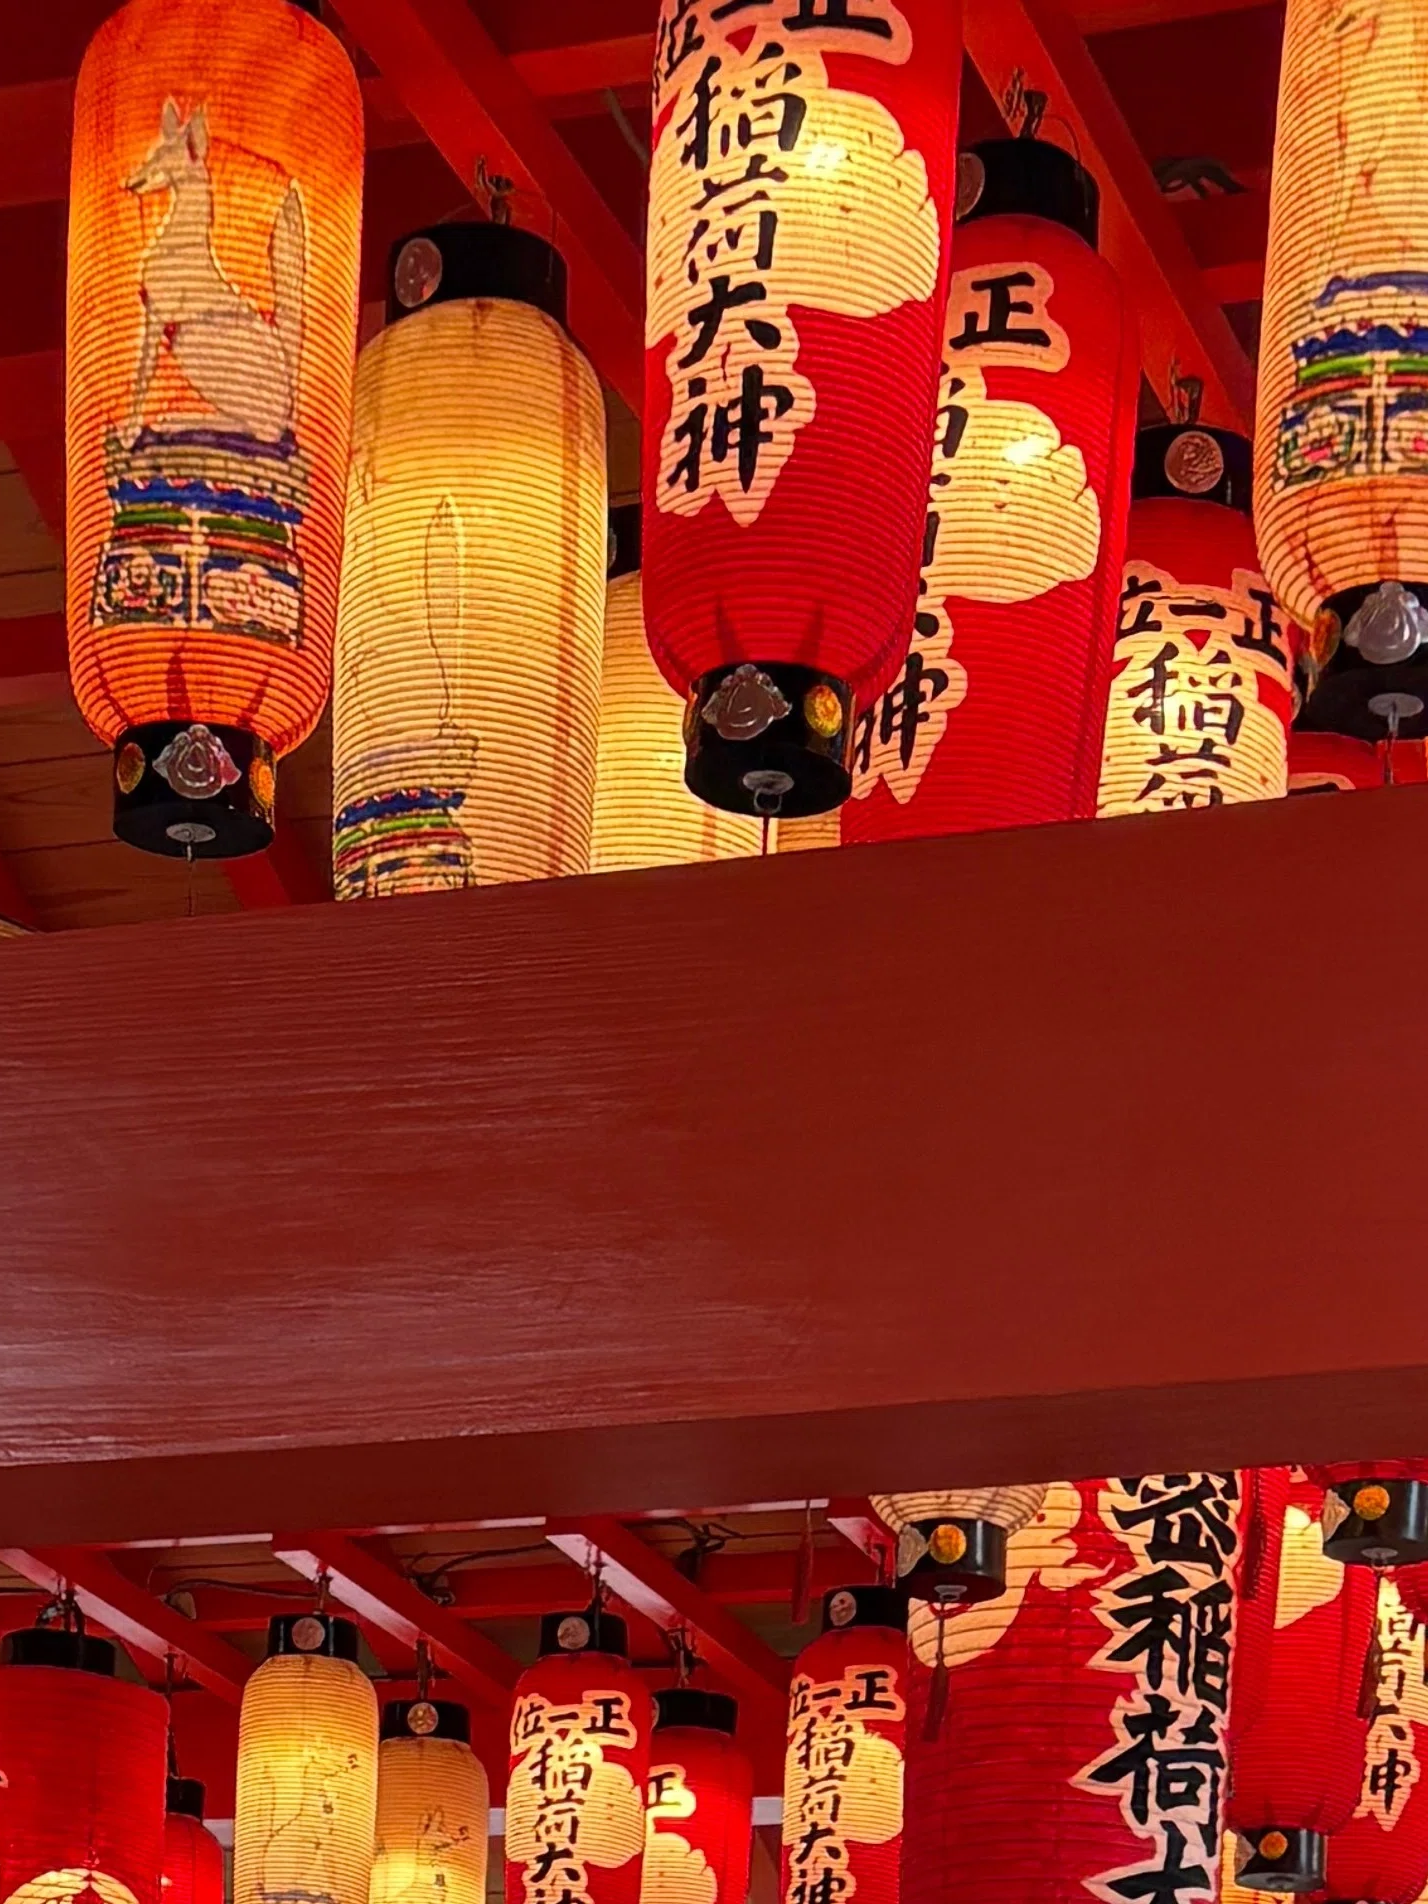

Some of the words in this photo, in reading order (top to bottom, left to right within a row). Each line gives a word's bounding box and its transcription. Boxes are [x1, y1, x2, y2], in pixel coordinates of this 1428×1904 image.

[667, 42, 808, 494] 稲荷大神
[513, 1696, 631, 1747] 正一位
